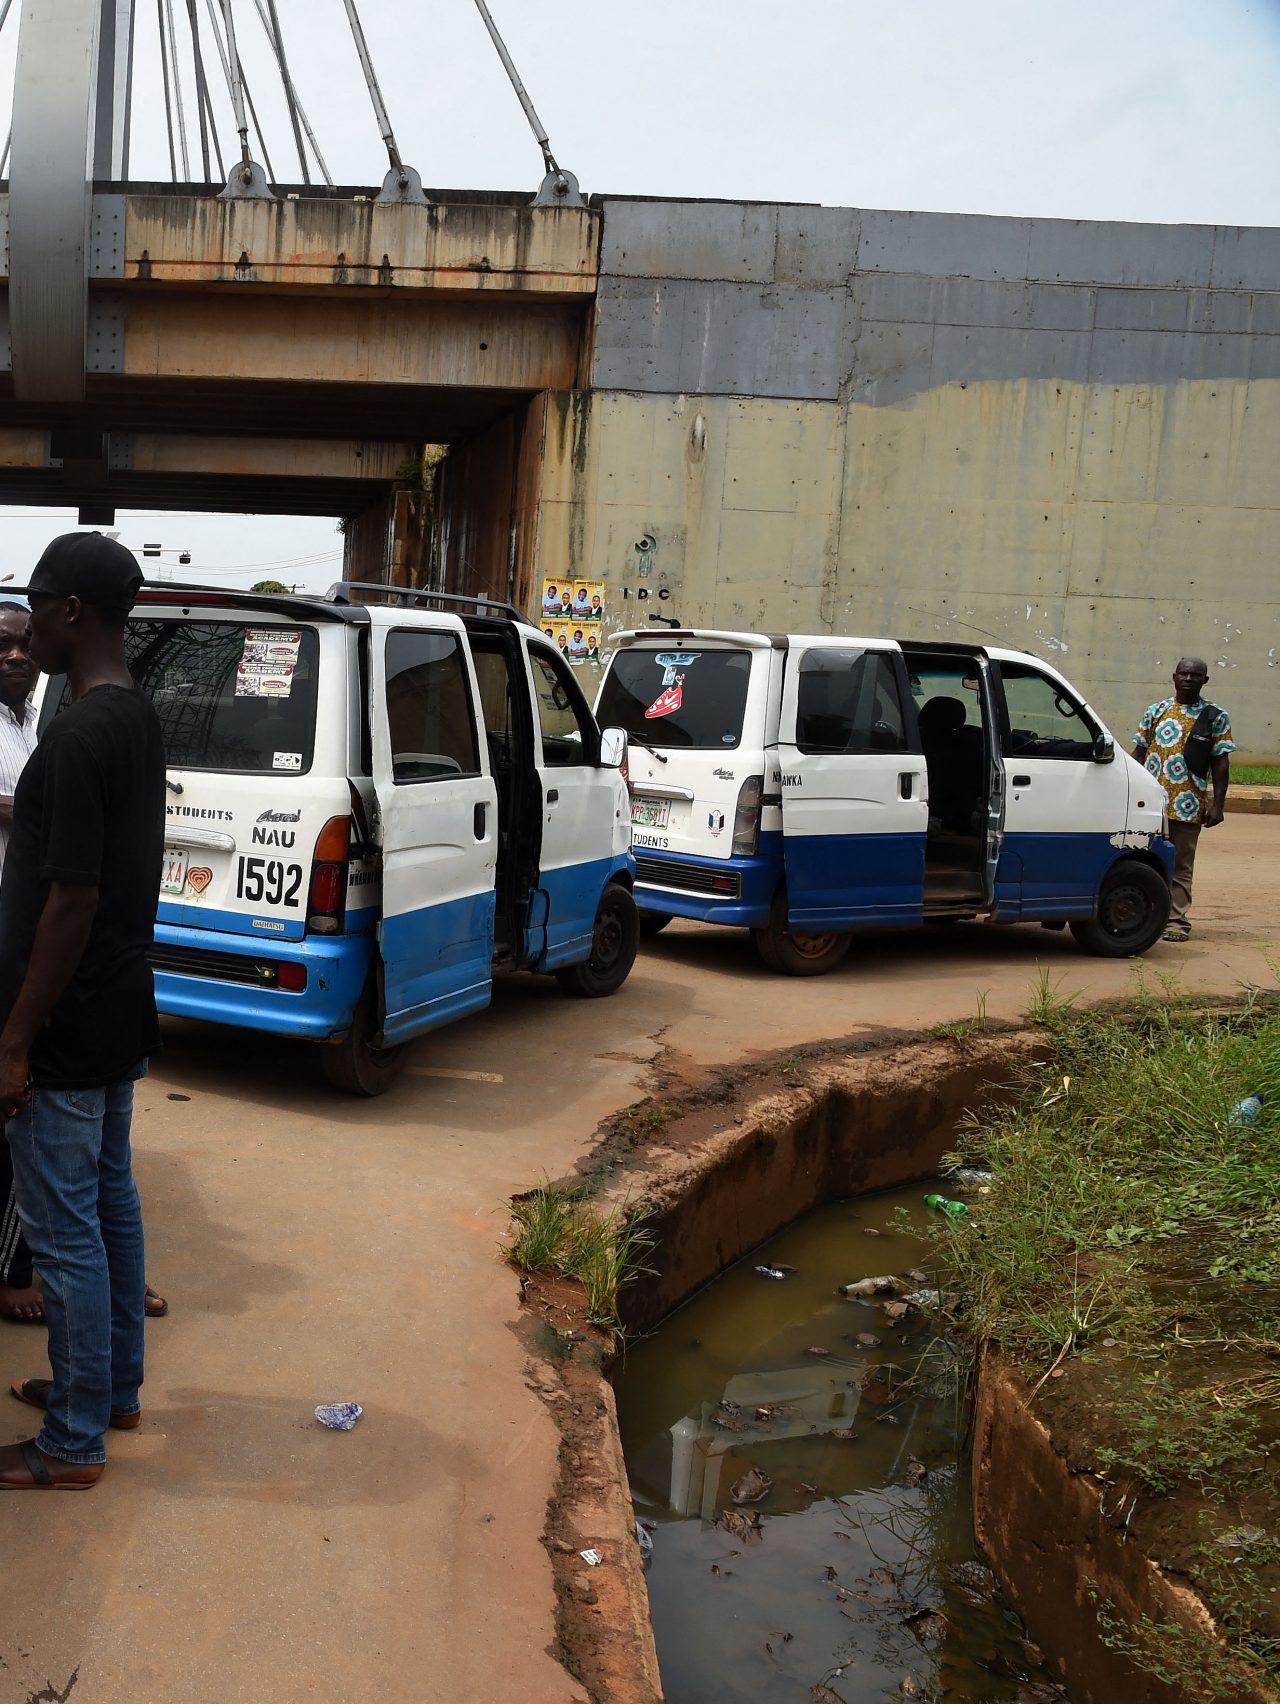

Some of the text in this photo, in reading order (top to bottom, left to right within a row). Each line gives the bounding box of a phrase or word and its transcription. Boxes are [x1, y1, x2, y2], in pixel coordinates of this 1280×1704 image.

[166, 805, 233, 821] STUDENTS
[252, 827, 295, 848] NAU
[633, 833, 668, 848] TUDENTS
[236, 855, 302, 907] 1592
